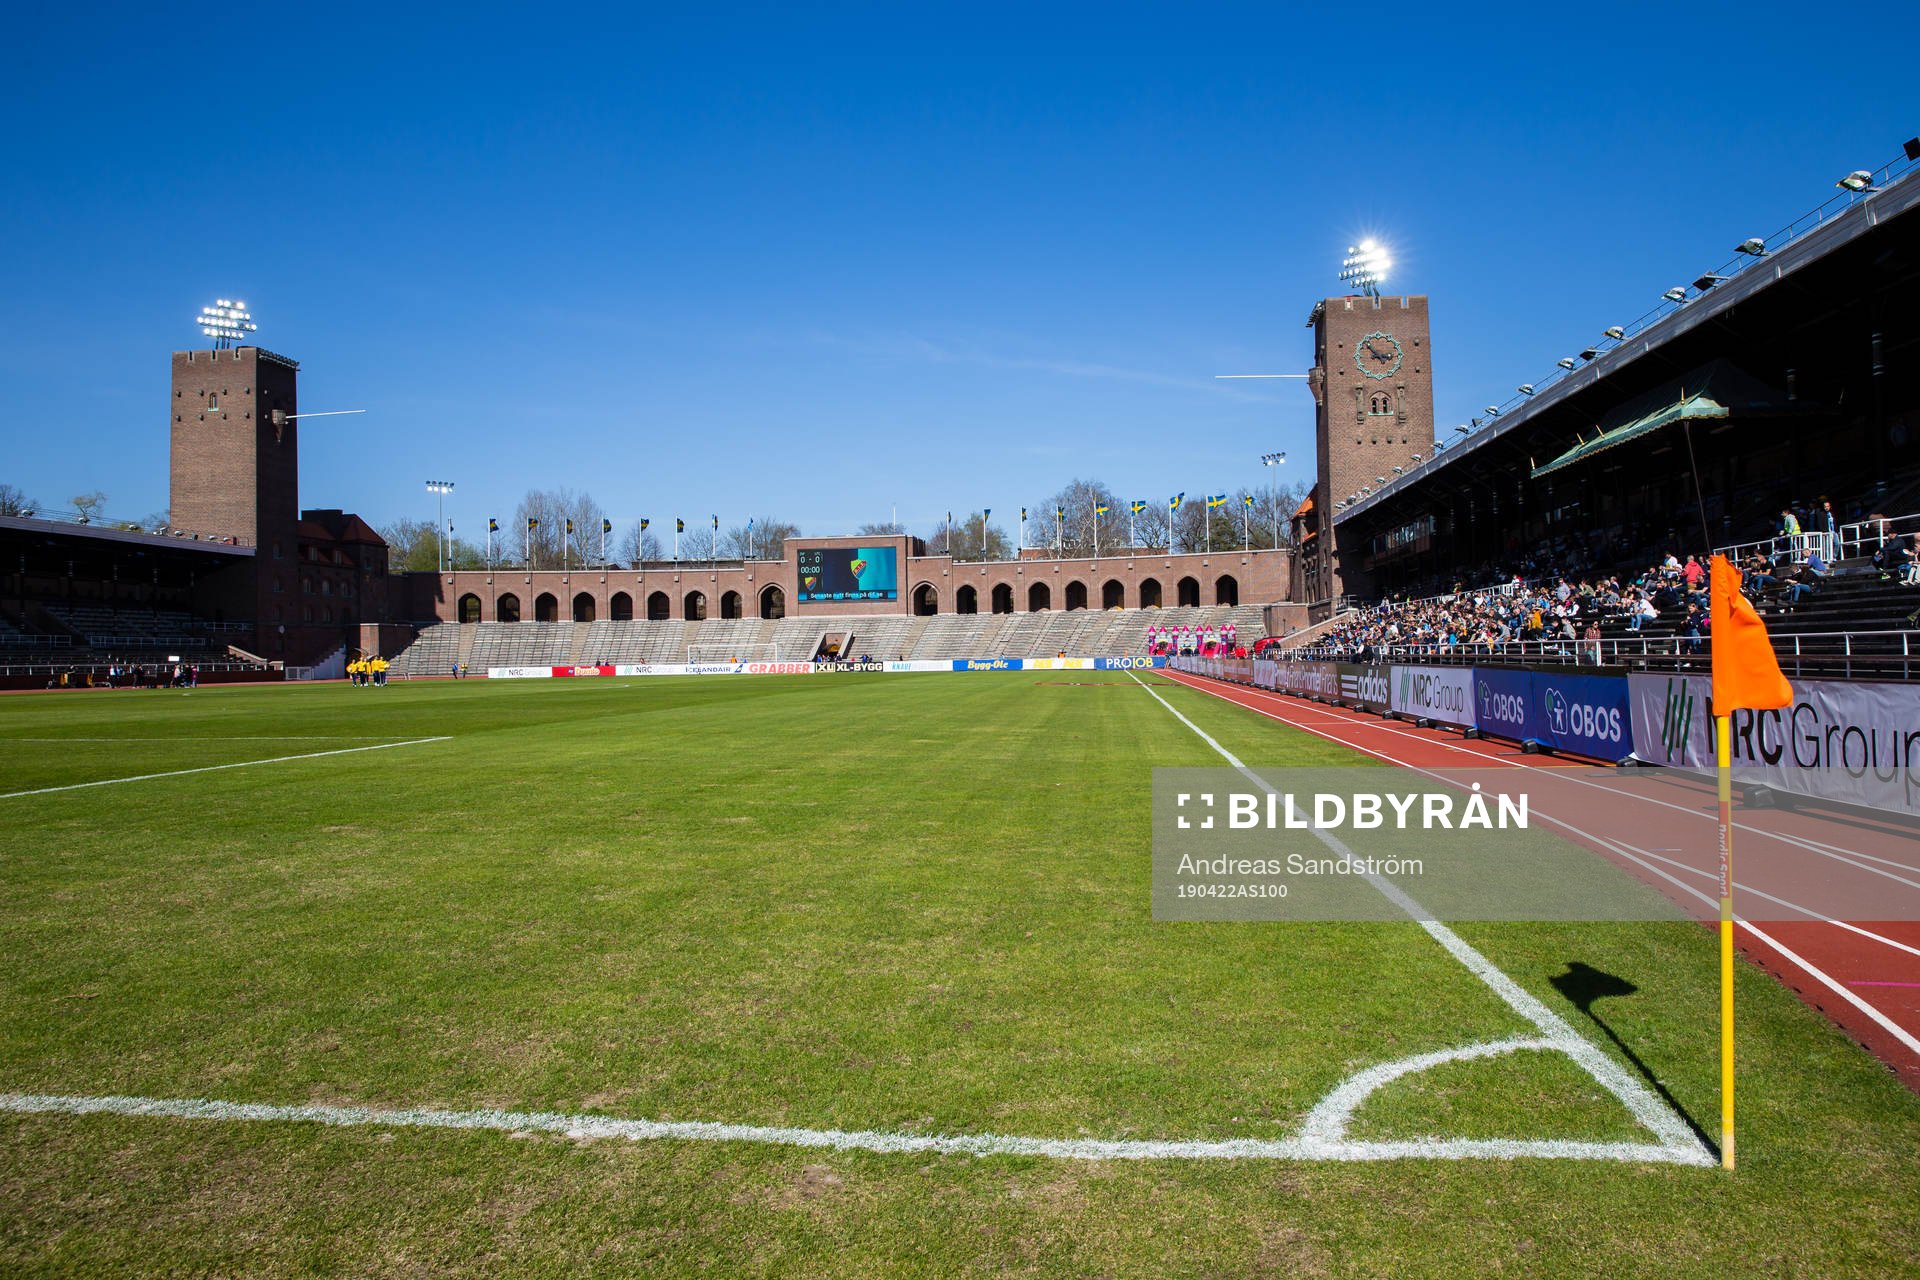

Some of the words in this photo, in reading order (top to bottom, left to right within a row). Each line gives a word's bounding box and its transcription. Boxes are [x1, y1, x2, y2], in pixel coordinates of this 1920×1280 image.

[800, 566, 820, 574] 00:00
[749, 663, 811, 674] GRABBER
[836, 662, 883, 671] XL-BYGG
[1358, 669, 1388, 704] adidas
[1412, 672, 1432, 708] NRC
[1433, 675, 1464, 713] Group
[1493, 693, 1524, 725] OBOS
[1570, 703, 1621, 743] OBOS
